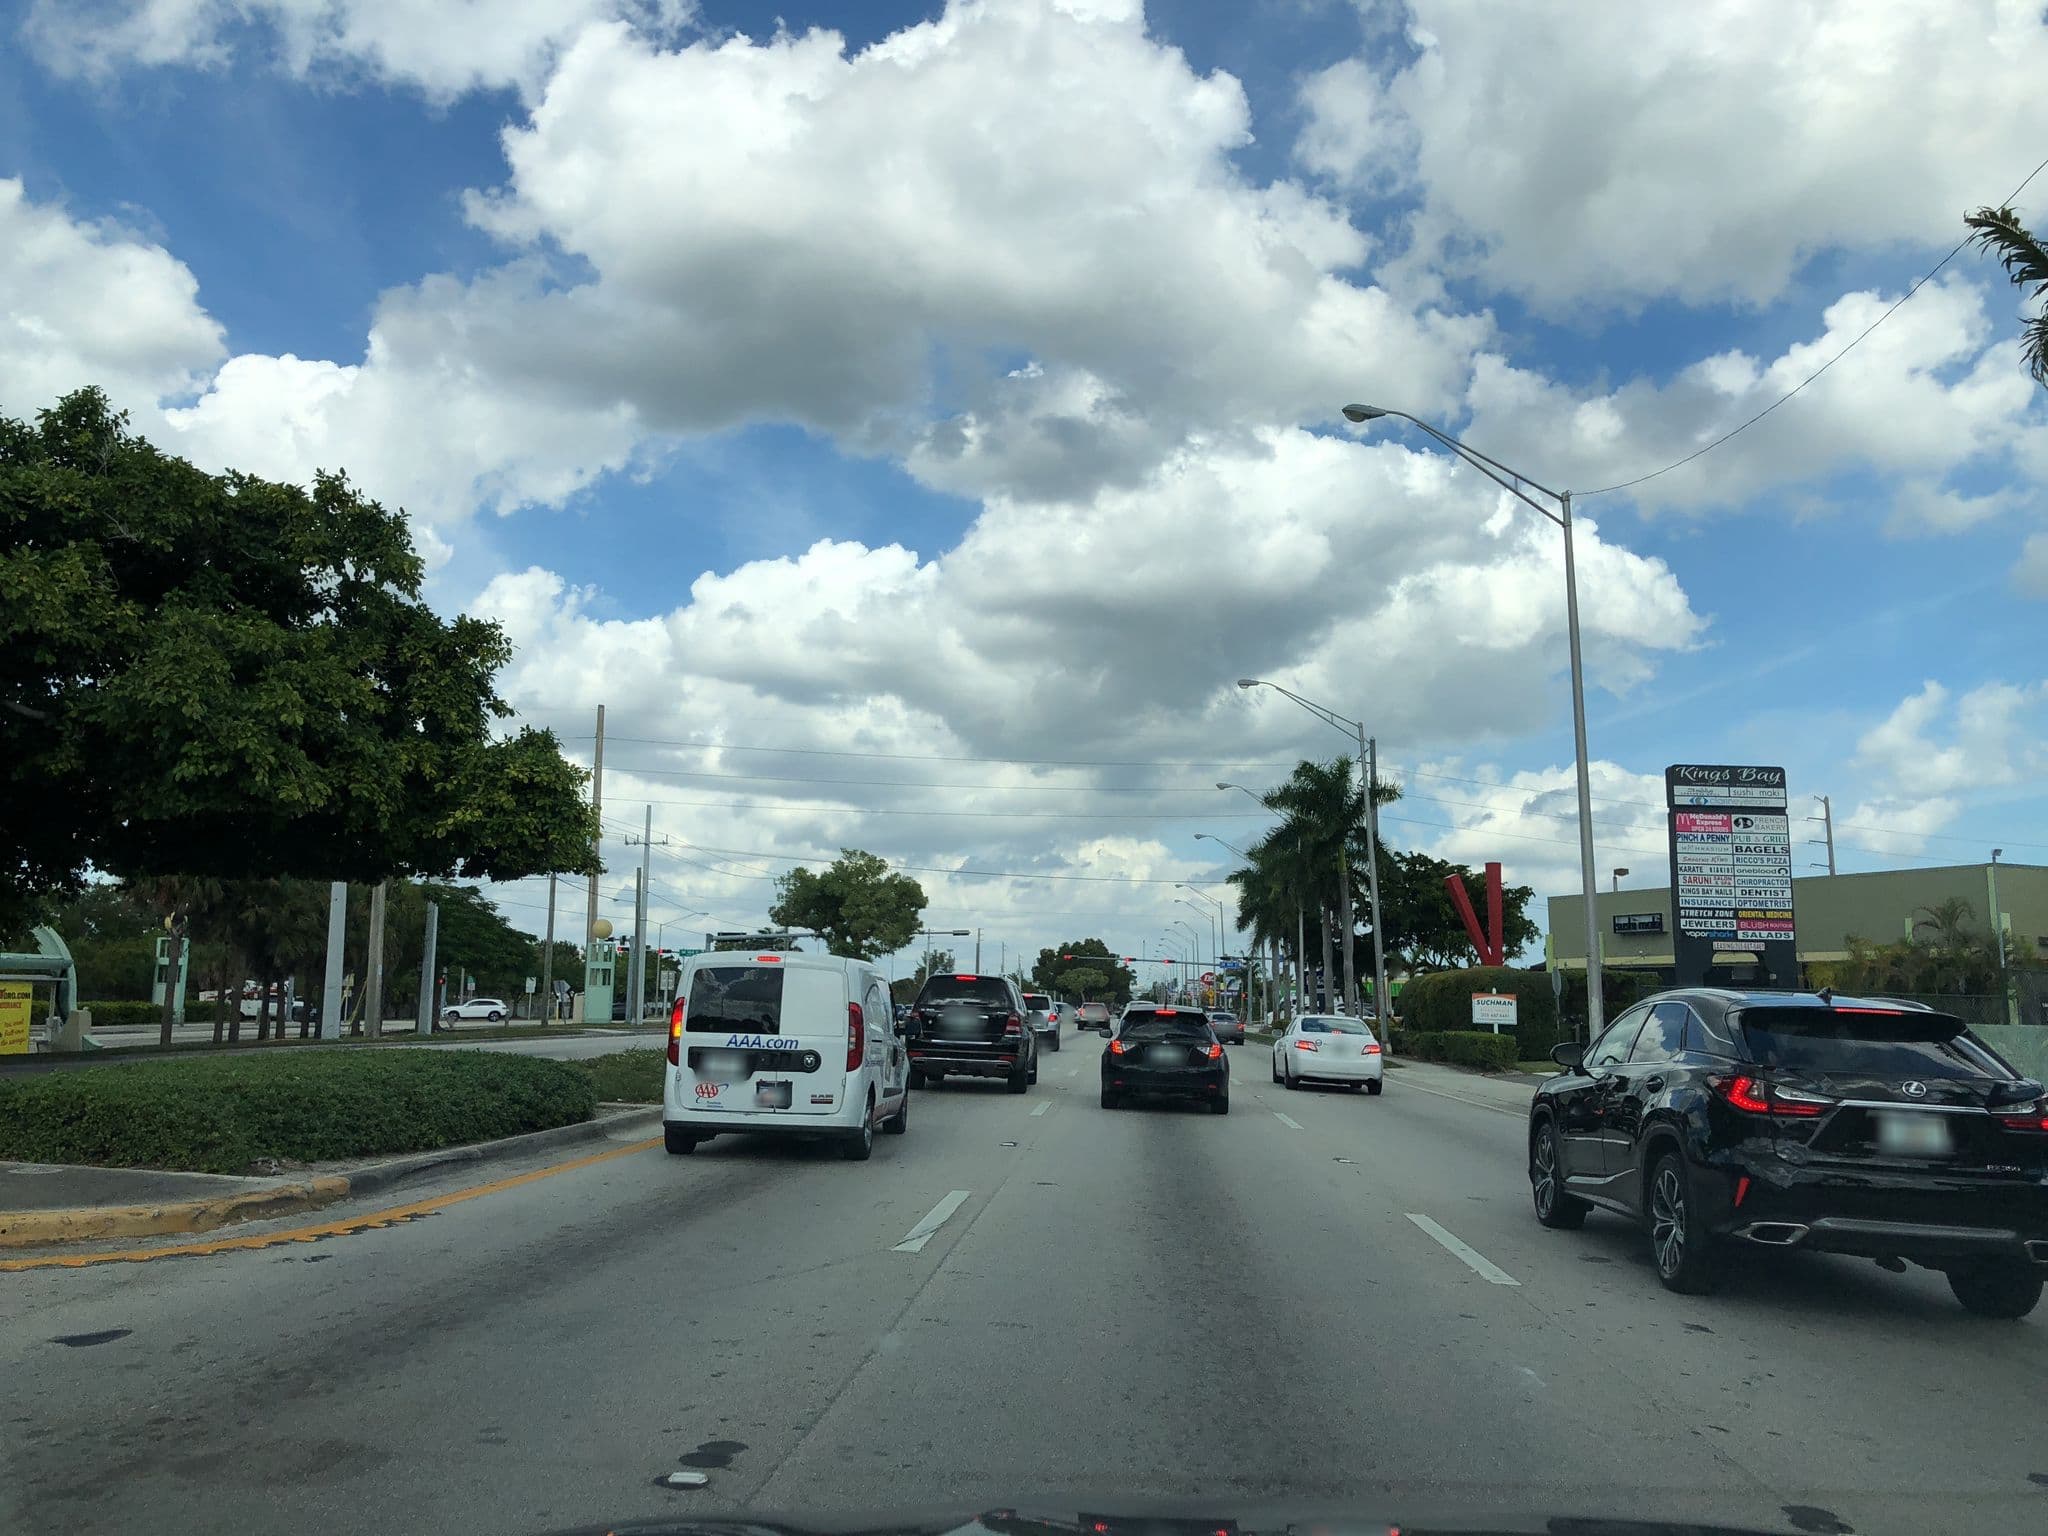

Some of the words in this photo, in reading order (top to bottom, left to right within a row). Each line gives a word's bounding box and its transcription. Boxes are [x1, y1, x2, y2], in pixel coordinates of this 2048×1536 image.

[1676, 766, 1730, 784] Kings
[1737, 768, 1781, 785] Bay
[1732, 788, 1754, 796] sushi
[1760, 788, 1780, 797] maki
[1754, 823, 1786, 831] BAKERY
[1677, 833, 1698, 842] PINCH
[1700, 834, 1706, 842] A
[1706, 834, 1730, 842] PENNY
[1762, 835, 1786, 843] GRILL
[1735, 845, 1789, 854] BAGELS
[1766, 857, 1788, 865] PIZZA
[1679, 865, 1704, 873] KARATE
[1736, 867, 1776, 875] oneblood
[1682, 876, 1712, 885] SARUNI
[1736, 878, 1790, 886] CHIROPRACTOR
[1680, 887, 1700, 895] KINGS
[1701, 887, 1714, 895] BAY
[1715, 888, 1733, 896] NAILS
[1740, 889, 1786, 897] DENTIST
[1680, 898, 1734, 907] INSURANCE
[1737, 900, 1791, 908] OPTOMETRIST
[1680, 909, 1713, 917] STRETCH
[1714, 910, 1734, 918] ZONE
[1765, 911, 1792, 919] MEDICINE
[1682, 920, 1735, 929] JEWELERS
[1740, 921, 1769, 929] BLUSH
[1741, 931, 1791, 939] SALADS
[1475, 999, 1513, 1007] SUCHMAN
[726, 1034, 799, 1049] AAA.com
[697, 1083, 718, 1098] AAA
